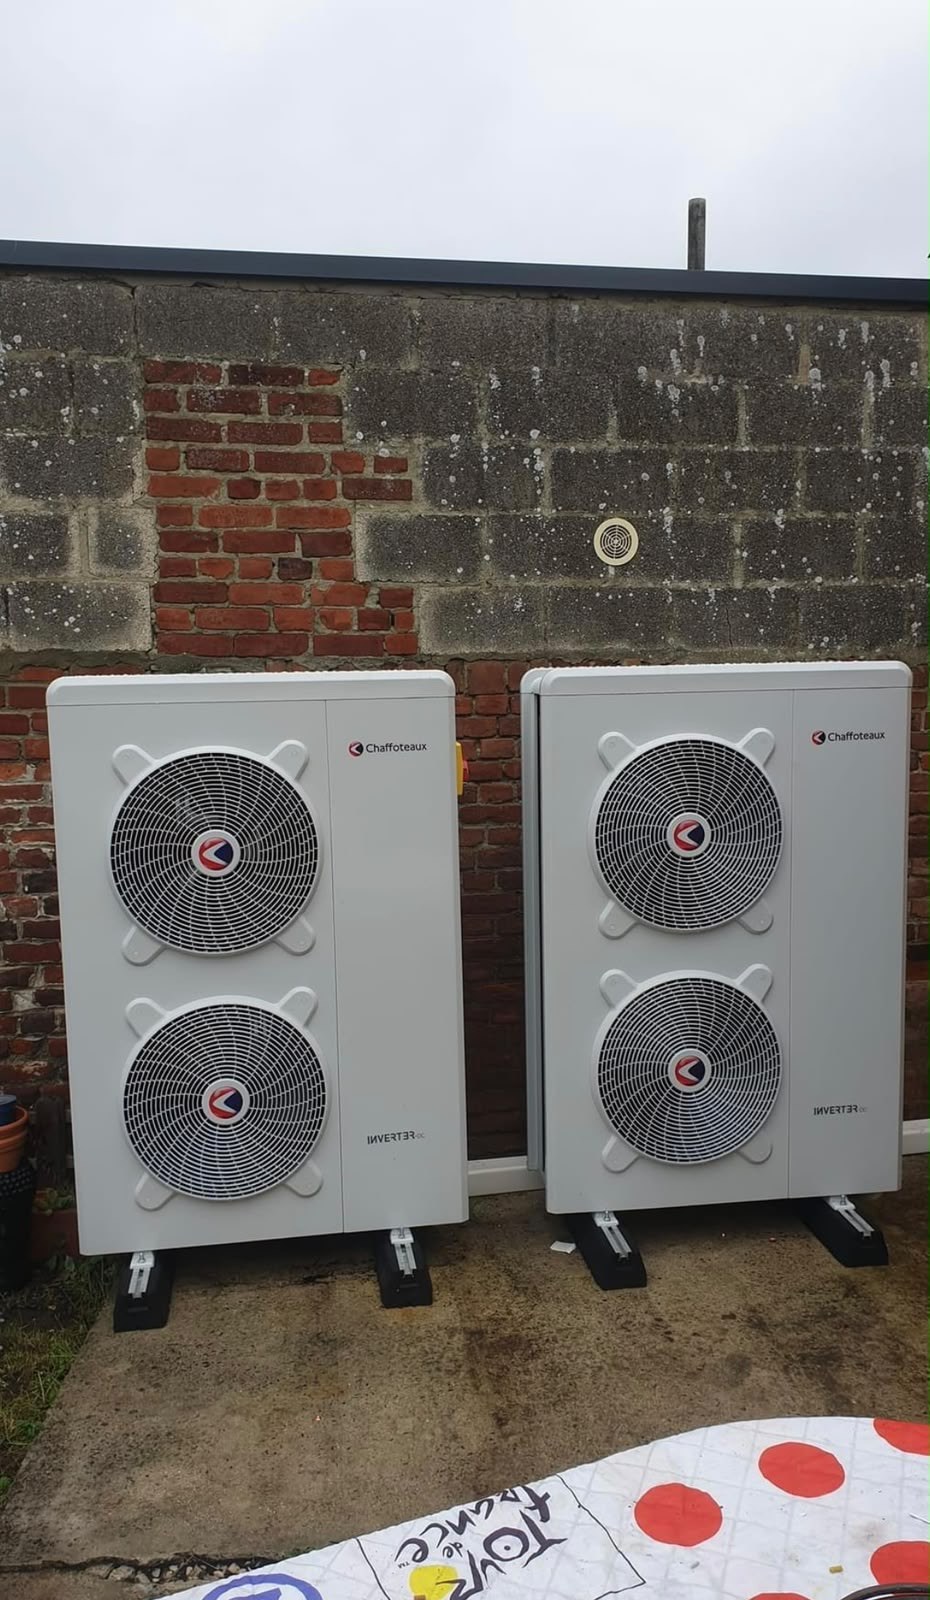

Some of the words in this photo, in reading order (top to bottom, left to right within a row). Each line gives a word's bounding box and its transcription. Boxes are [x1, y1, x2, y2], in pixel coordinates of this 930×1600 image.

[828, 731, 886, 742] Chaffoteaux
[365, 742, 427, 753] Chaffoteaux
[813, 1104, 858, 1116] INVERTER
[367, 1130, 415, 1145] INVERTER
[442, 1541, 464, 1559] de
